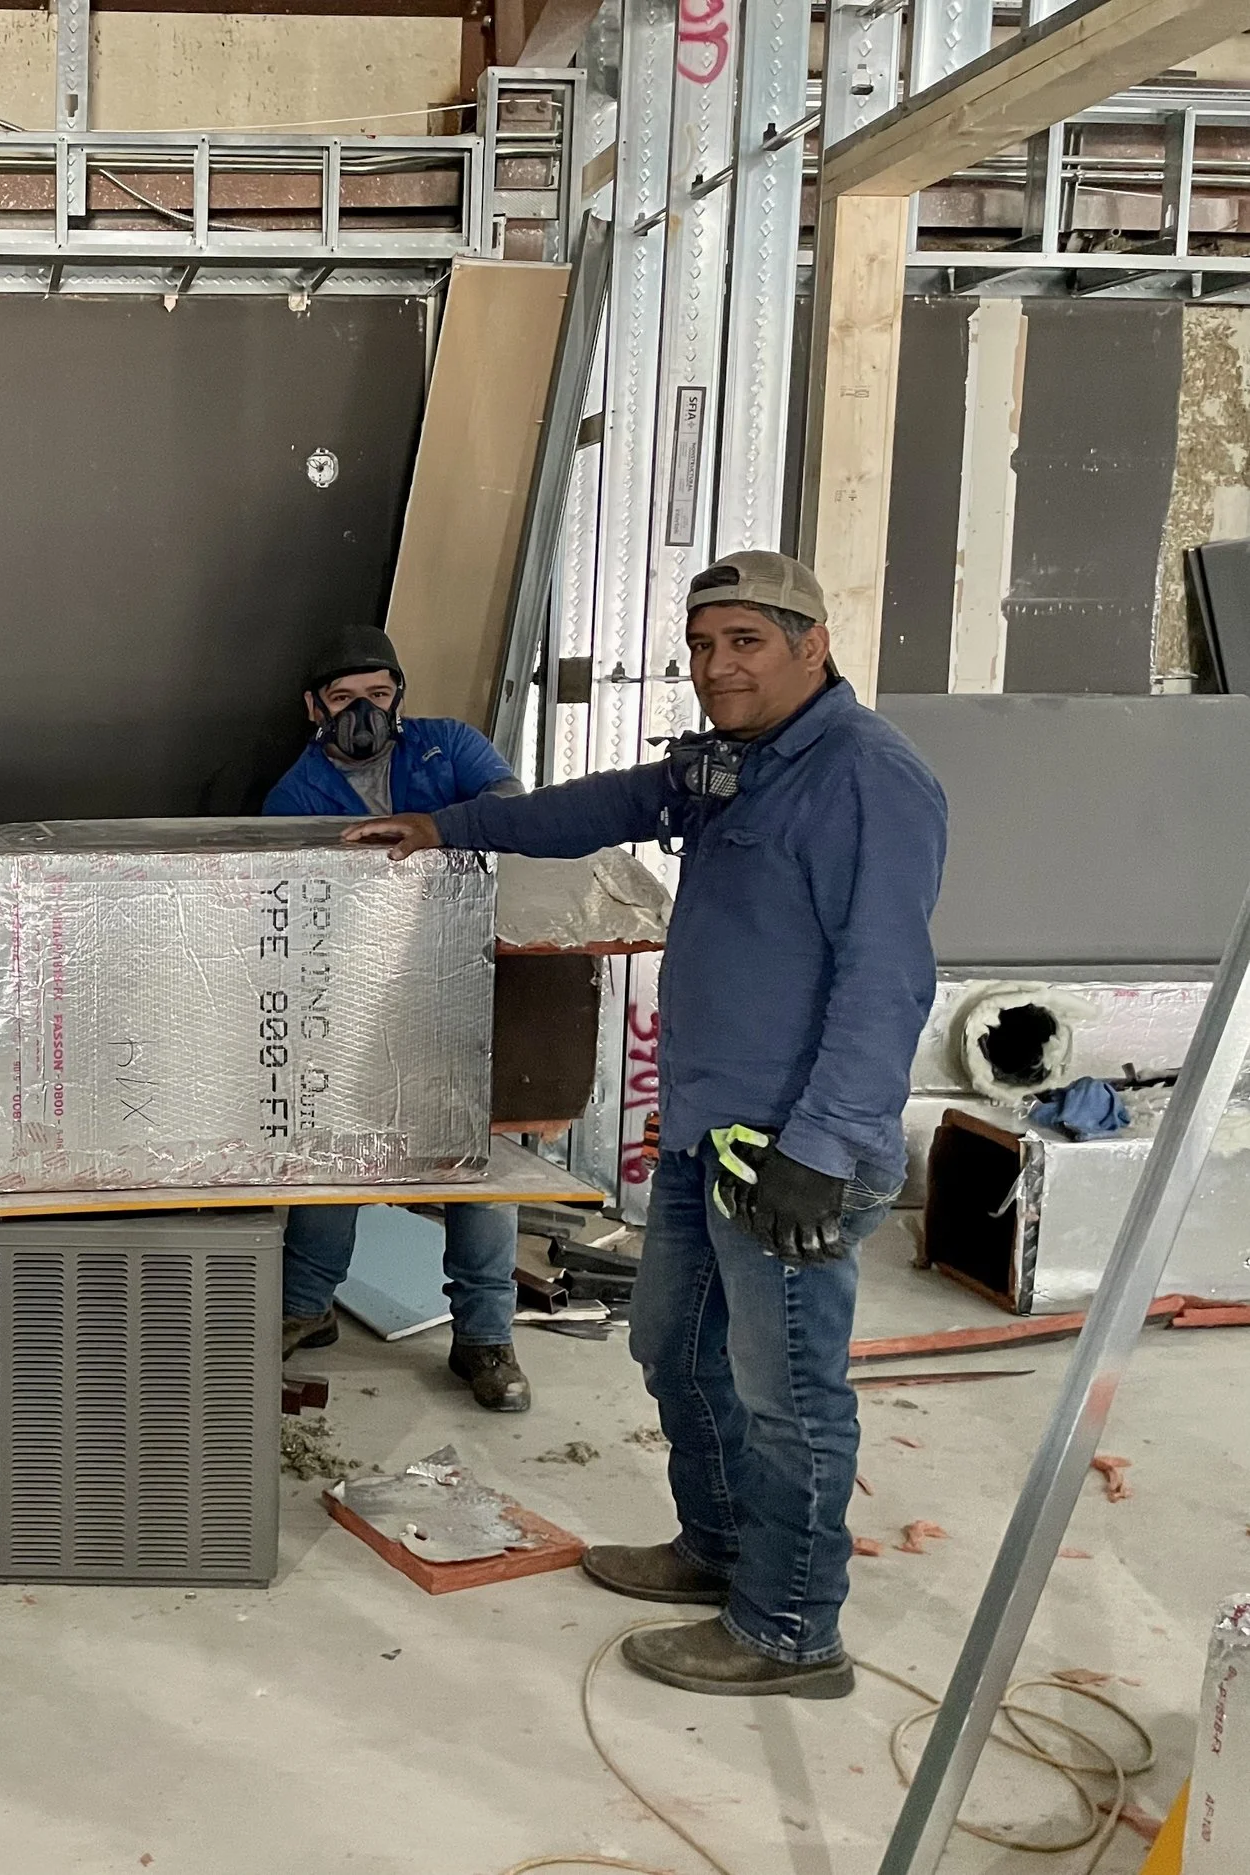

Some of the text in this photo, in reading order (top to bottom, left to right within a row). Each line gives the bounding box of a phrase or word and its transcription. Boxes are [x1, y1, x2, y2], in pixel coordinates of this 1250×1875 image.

[687, 396, 698, 421] SFIA
[53, 1014, 65, 1072] FASSON
[53, 1083, 64, 1116] 0800
